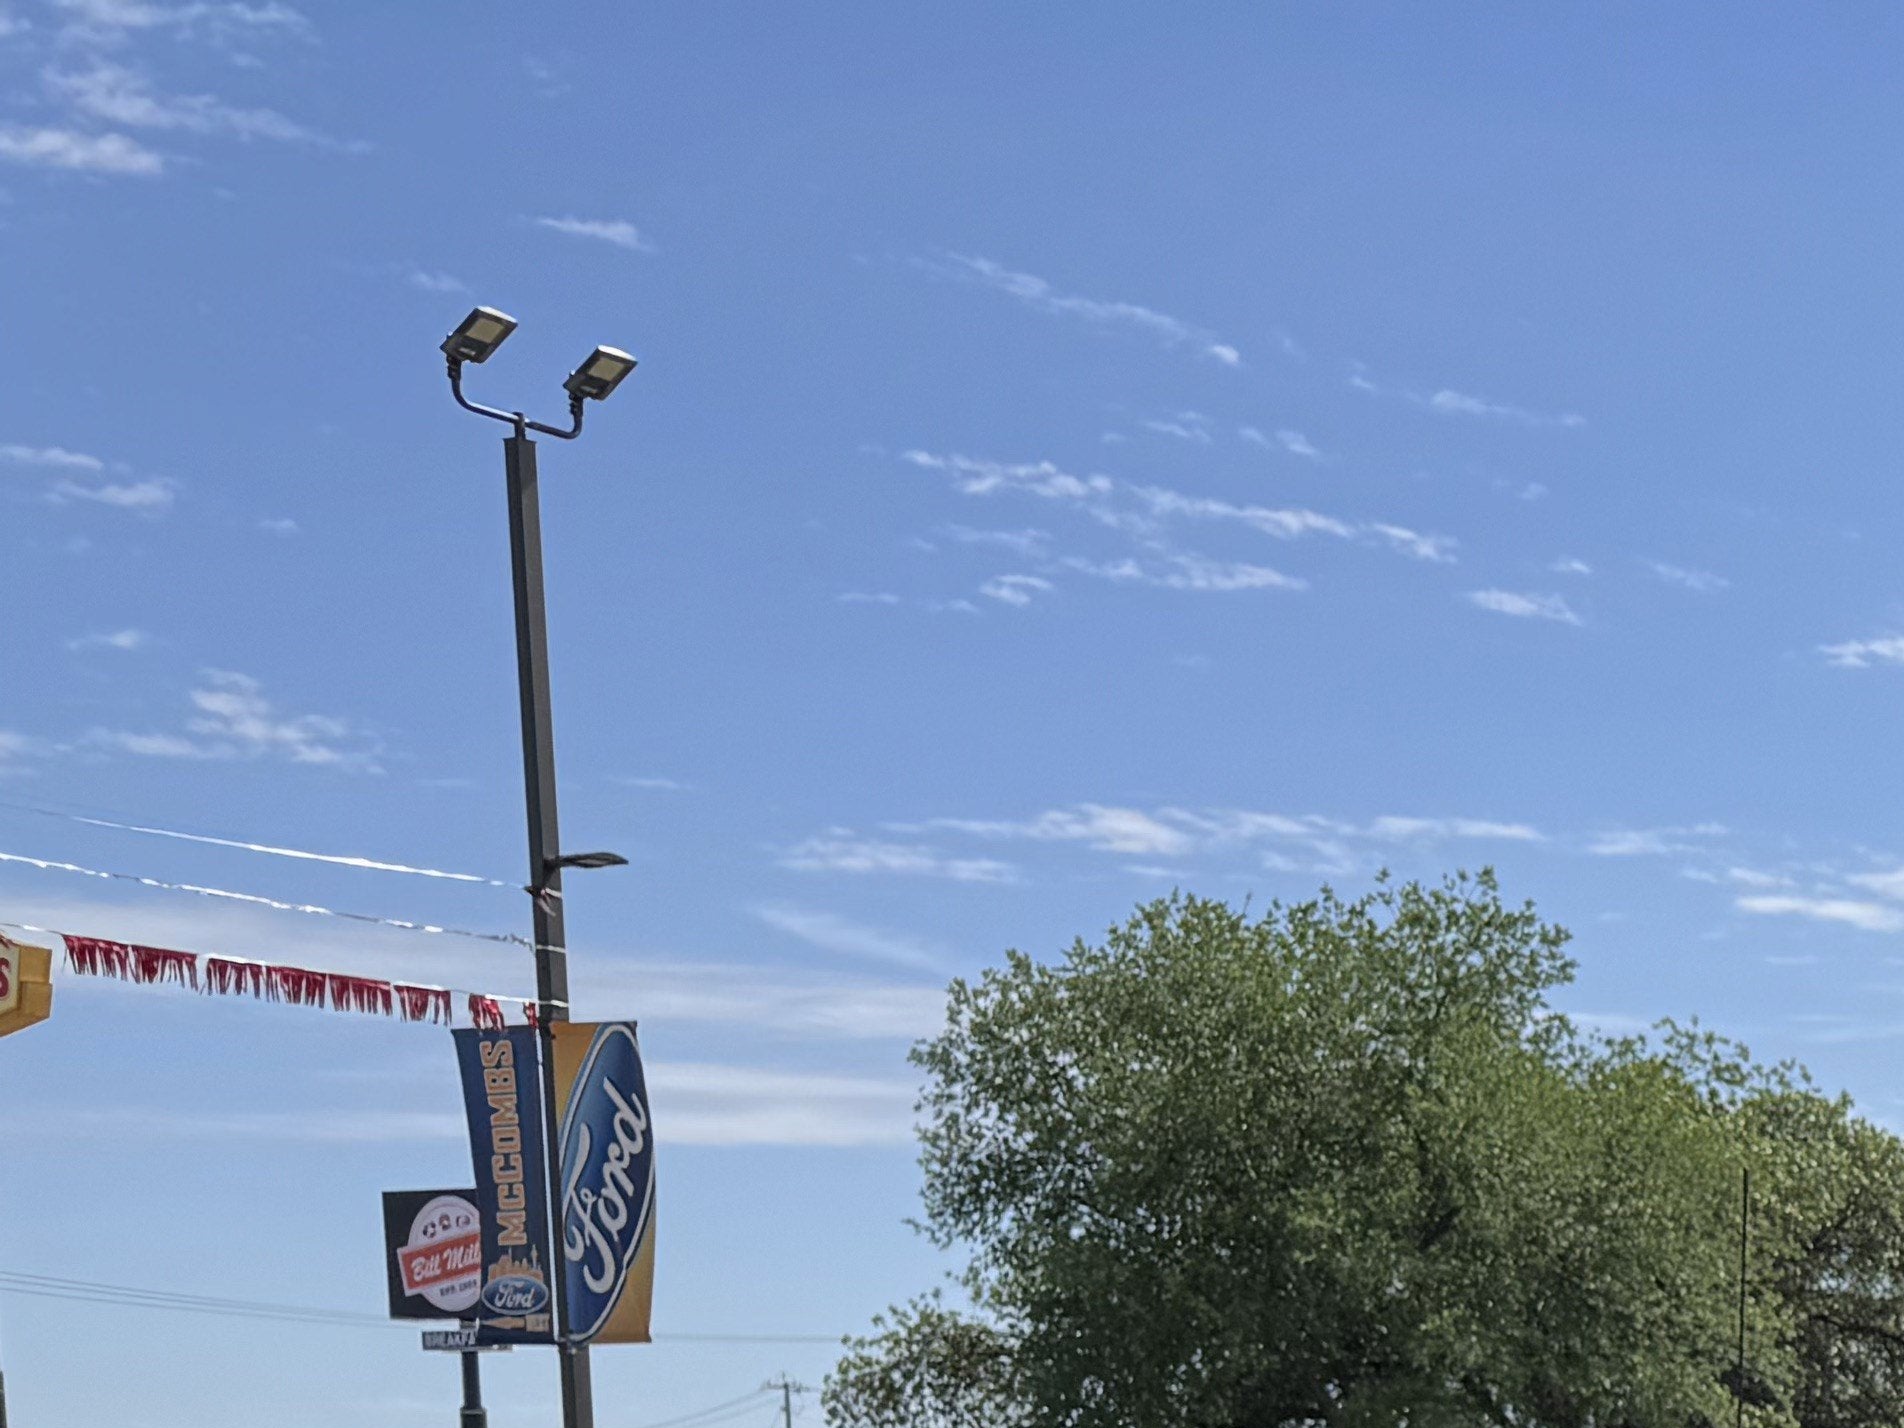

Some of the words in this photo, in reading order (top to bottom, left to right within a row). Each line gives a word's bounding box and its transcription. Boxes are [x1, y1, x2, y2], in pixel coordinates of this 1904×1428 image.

[479, 1039, 527, 1246] MCCOMBS
[564, 1076, 647, 1293] Ford
[411, 1252, 441, 1282] Bill
[442, 1241, 481, 1270] Mill
[495, 1280, 535, 1309] Ford
[424, 1329, 477, 1347] BREAKFA
